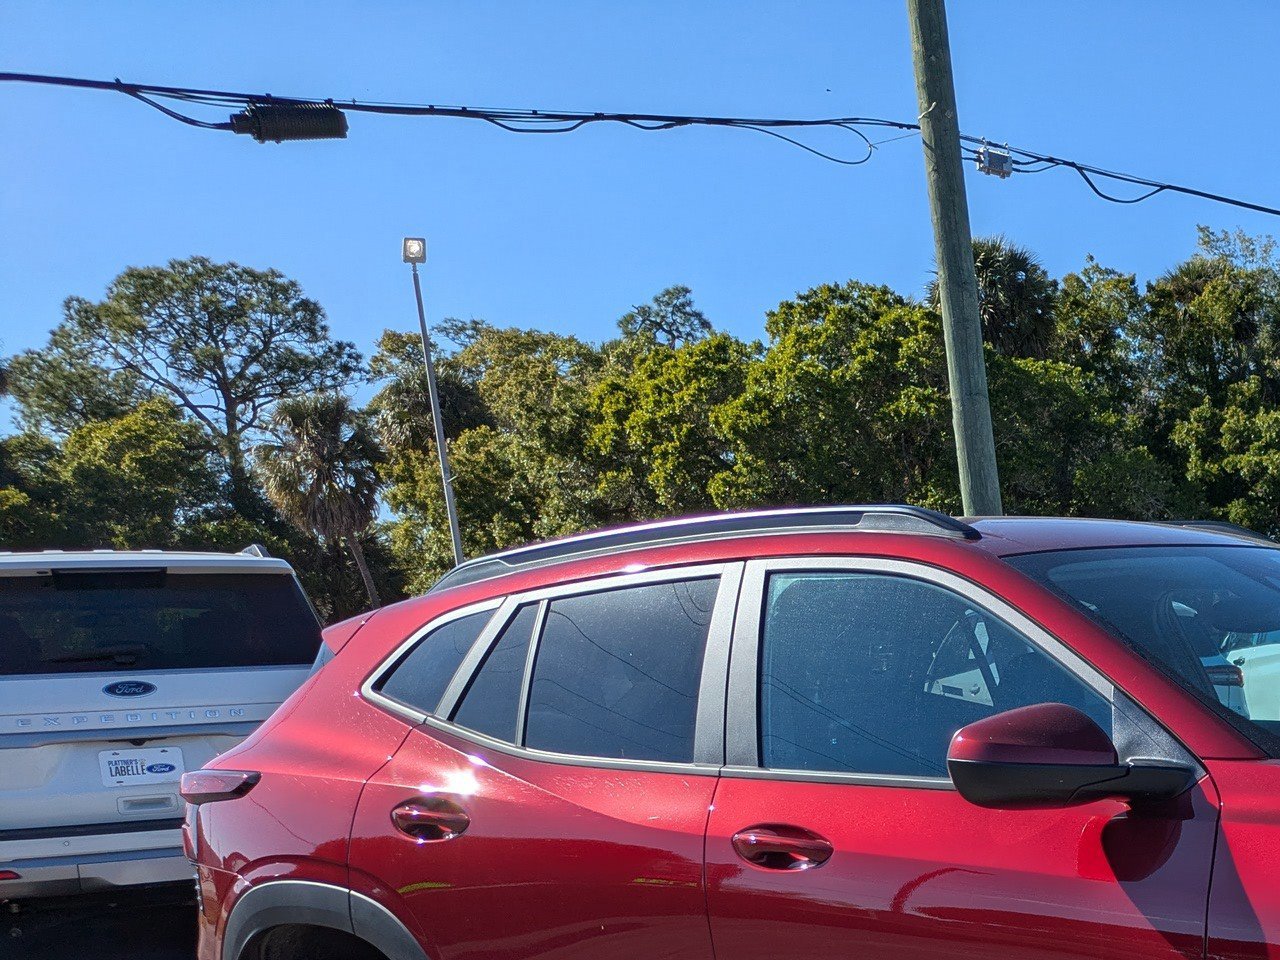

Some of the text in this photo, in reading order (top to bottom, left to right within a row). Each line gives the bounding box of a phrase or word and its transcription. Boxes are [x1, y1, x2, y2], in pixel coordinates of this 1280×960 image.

[16, 708, 245, 728] EXPEDITION
[107, 758, 139, 767] PLATTNER'S
[109, 764, 147, 778] LABELLE
